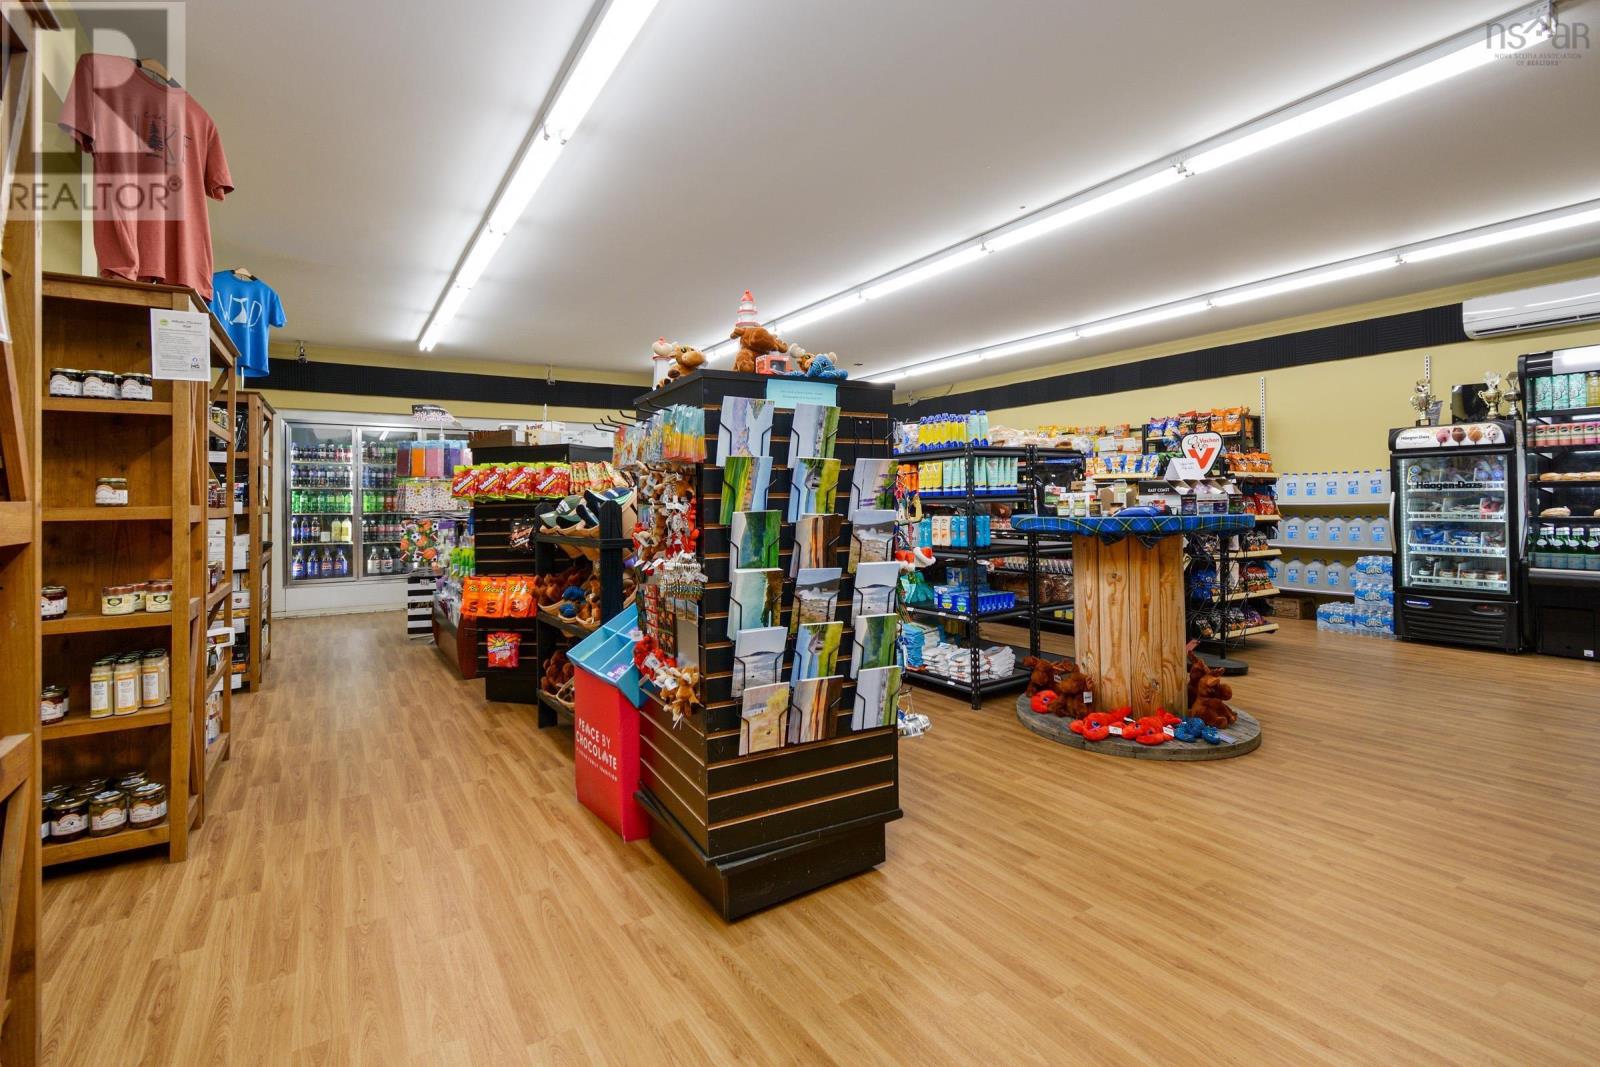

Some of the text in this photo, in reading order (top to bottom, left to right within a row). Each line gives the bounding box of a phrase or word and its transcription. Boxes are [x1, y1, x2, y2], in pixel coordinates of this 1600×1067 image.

[576, 731, 617, 770] CHOCOLATE
[578, 718, 611, 750] PEACE BY
